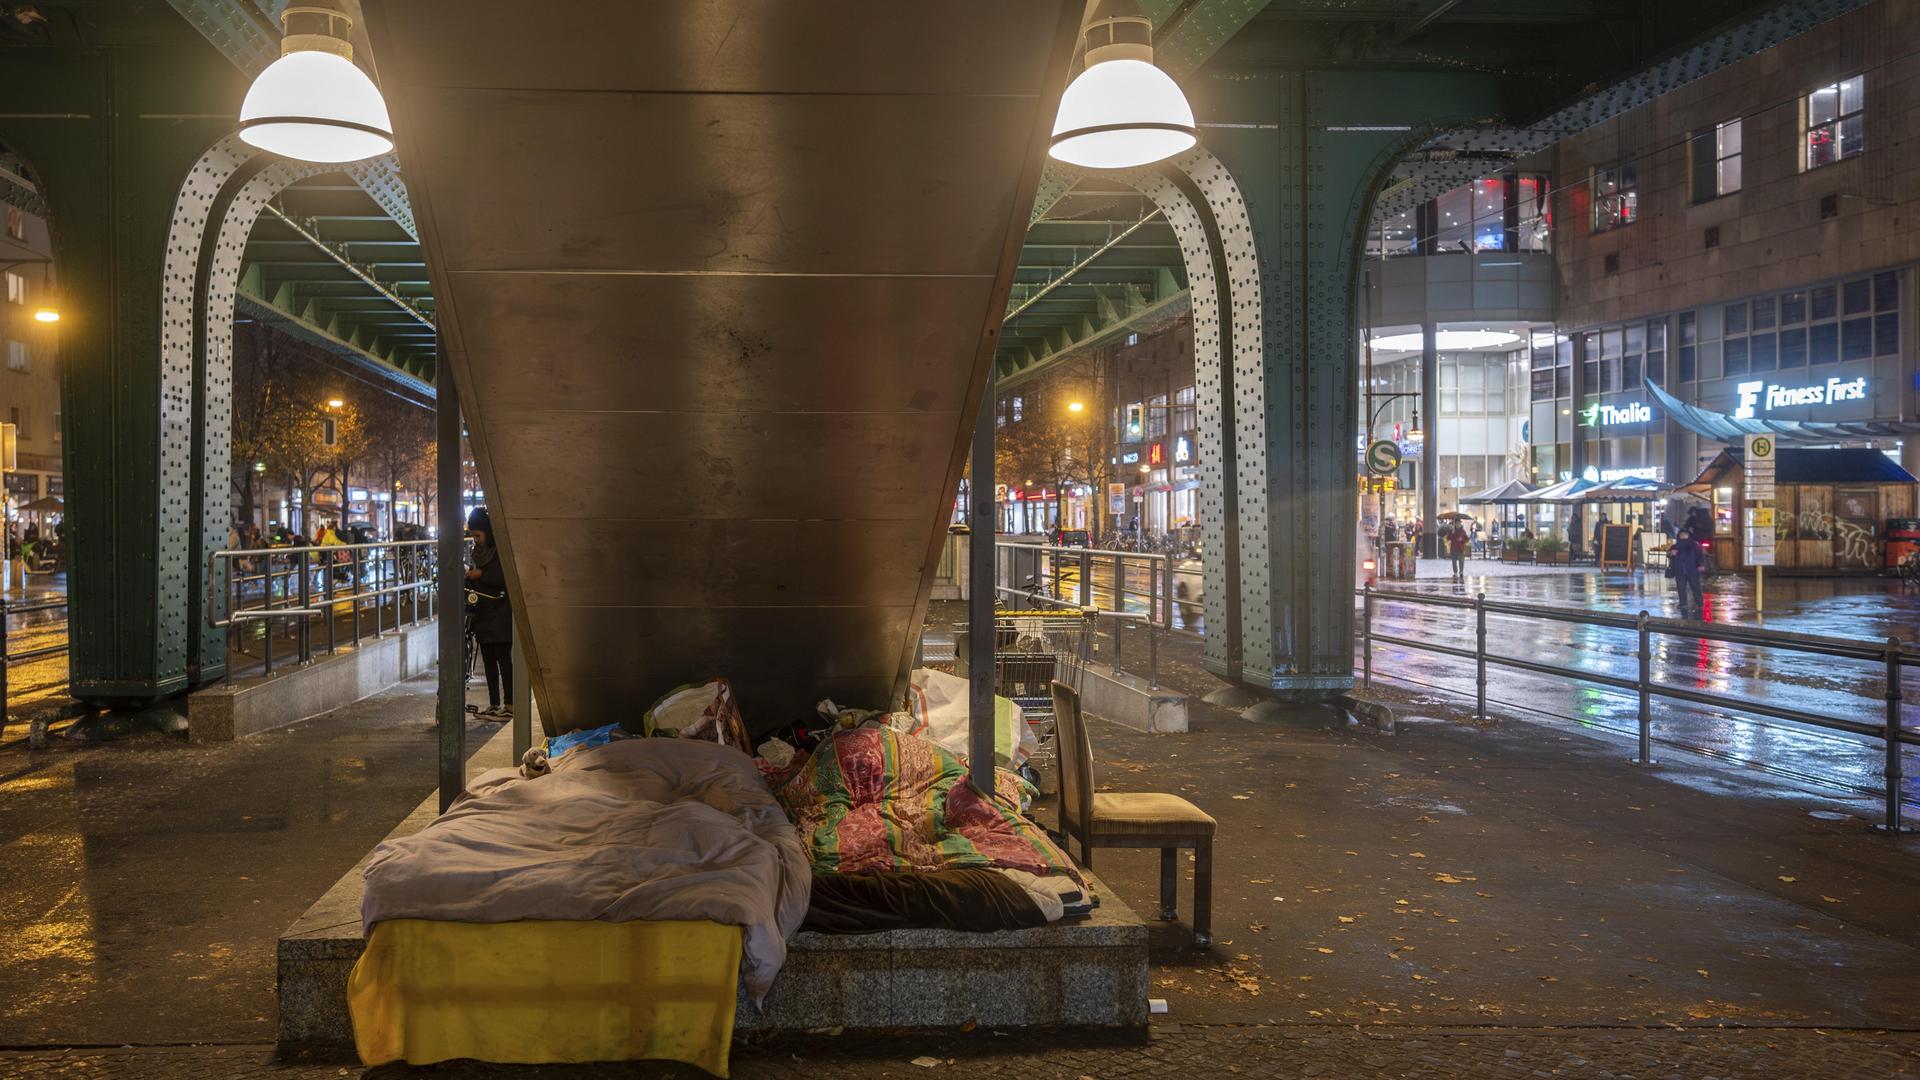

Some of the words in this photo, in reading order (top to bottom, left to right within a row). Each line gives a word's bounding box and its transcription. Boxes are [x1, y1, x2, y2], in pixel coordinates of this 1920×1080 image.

[1766, 384, 1824, 410] Fitness
[1826, 377, 1866, 404] First
[1600, 402, 1651, 425] Thalia
